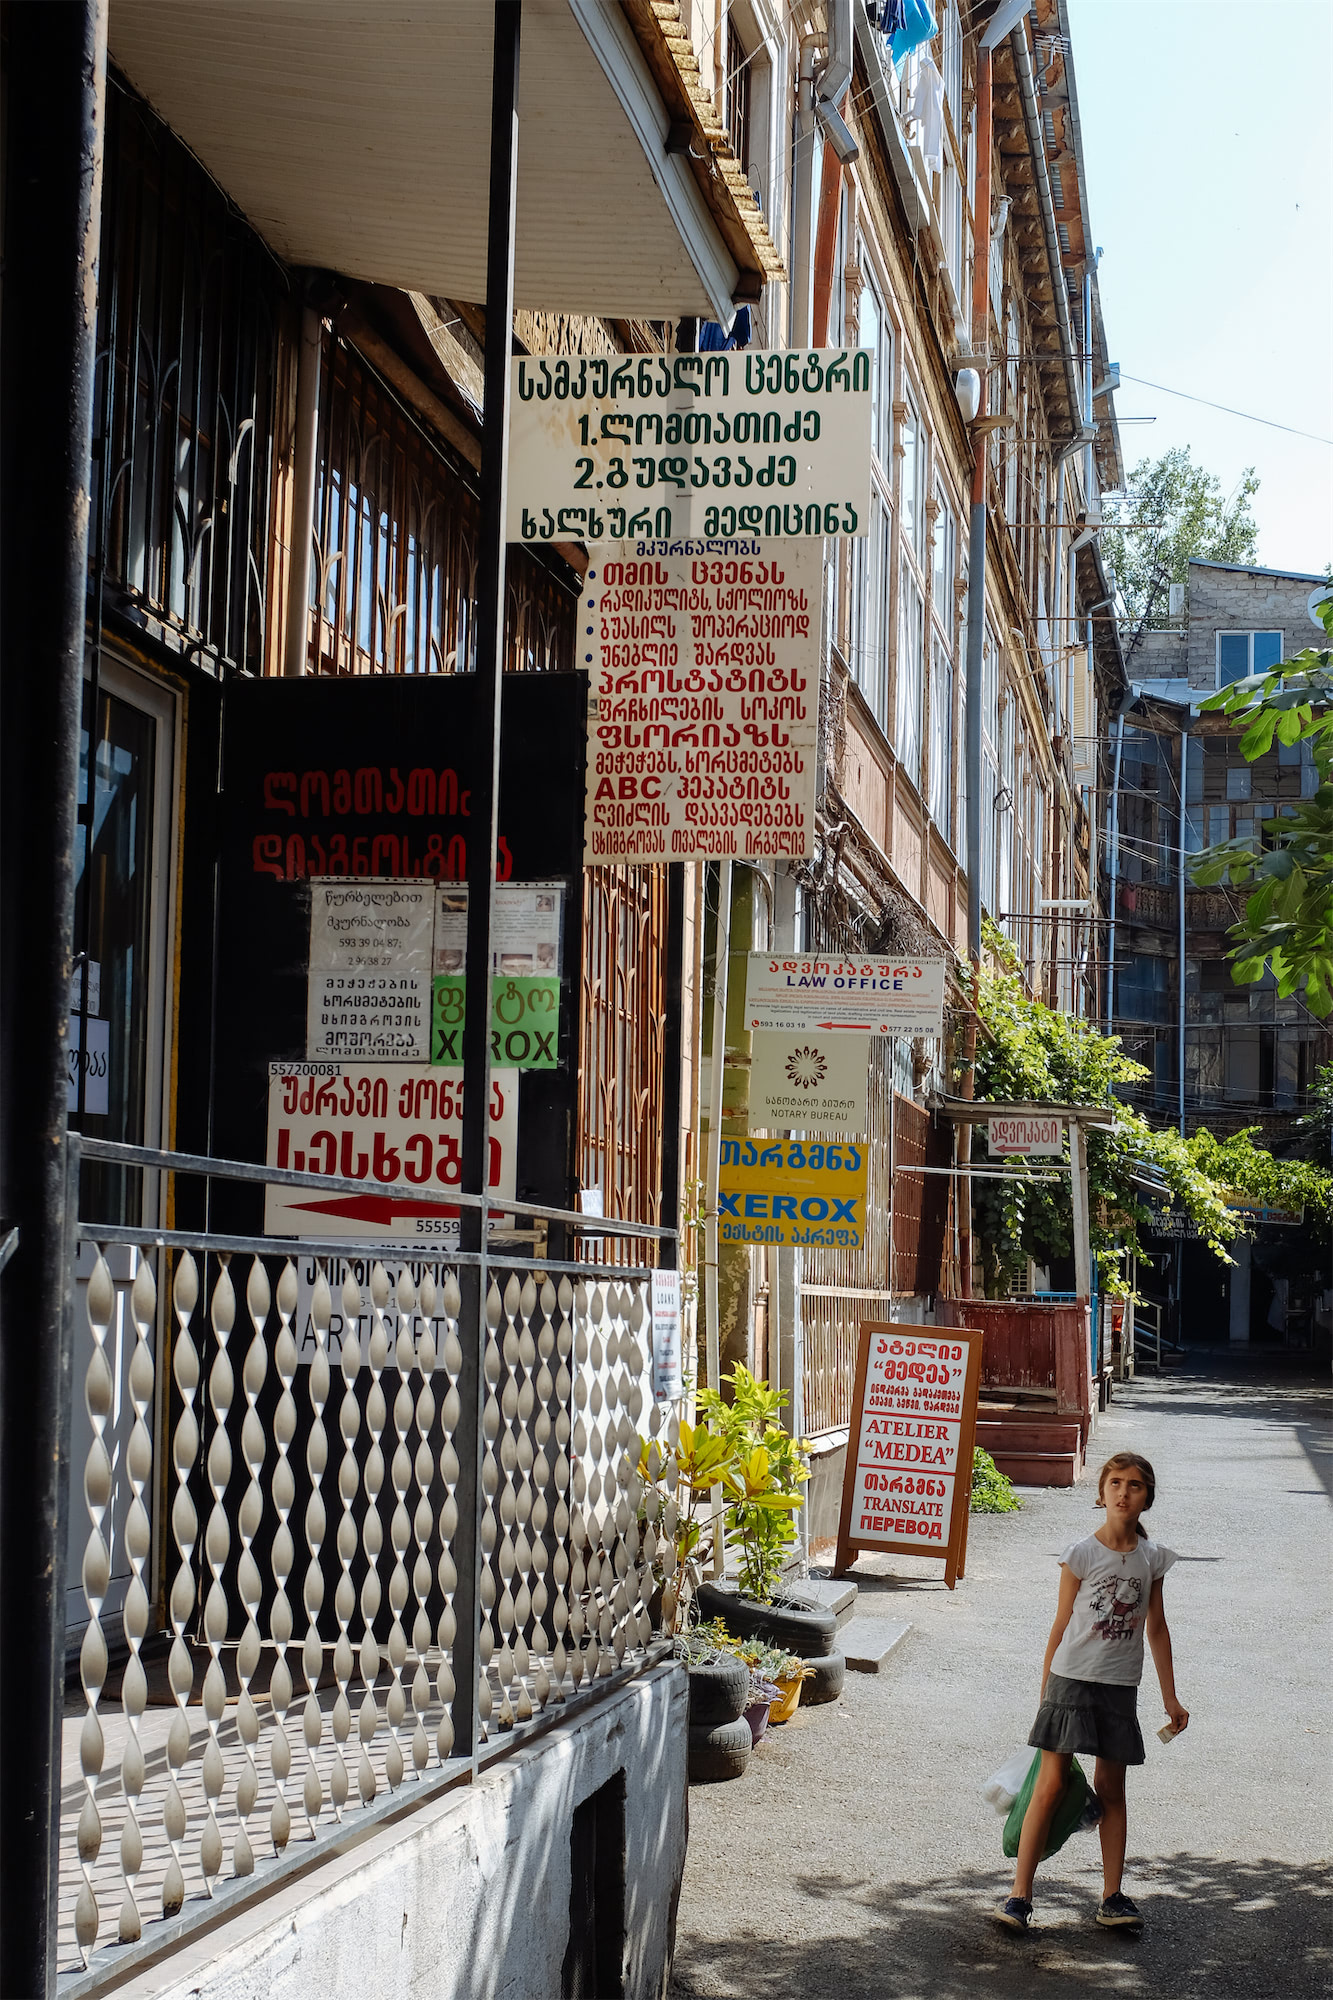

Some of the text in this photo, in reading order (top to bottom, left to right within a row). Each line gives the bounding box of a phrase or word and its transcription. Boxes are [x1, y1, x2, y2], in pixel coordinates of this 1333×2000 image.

[519, 351, 870, 400] სამკურნალო ცენტრი
[577, 410, 821, 446] 1.ლომთათიძე
[573, 455, 797, 490] 2.გუდავაძე
[522, 502, 858, 539] ხალხური მედიცინა
[636, 540, 761, 557] მკურნალობს
[603, 561, 785, 586] თმის ცვენას
[600, 588, 808, 613] რადიკულიტს, სქოლიოზს
[600, 614, 810, 640] ბუასილს უოპერაციოდ
[600, 642, 775, 668] უნებლიე შარდვას
[599, 669, 807, 695] პროსტატიტს
[600, 696, 807, 722] ფრჩხილების სოკოს
[596, 724, 790, 749] ფსორიაზს
[596, 750, 804, 775] მეჭეჭებს, ხორცმეტებს
[594, 775, 790, 800] ABC ჰეპატიტს
[593, 802, 804, 827] ღვიძლის დაავადებებს
[592, 829, 805, 855] ცხიმგროვას თვალების ირგვლივ
[327, 915, 411, 931] მკურნალობა
[339, 938, 356, 948] 593
[358, 938, 371, 948] 39
[768, 960, 923, 979] ადვოკატურა
[786, 975, 903, 991] LAW OFFICE
[323, 995, 421, 1009] ხორცმეტების
[437, 981, 556, 1025] ფტო
[760, 1020, 774, 1028] 593
[436, 1029, 555, 1062] XROX
[270, 1063, 342, 1076] 557200081
[281, 1076, 504, 1122] უძრავი ქონეა
[765, 1096, 855, 1109] სანოტარო ბიურო
[771, 1109, 848, 1121] NOTARY BUREAU
[991, 1121, 1058, 1144] ადვოკატი
[720, 1140, 861, 1172] თარგმნა
[718, 1192, 857, 1223] XEROX
[722, 1223, 860, 1247] ექსტის აკრეფა
[877, 1339, 962, 1361] ატელიე
[865, 1419, 950, 1441] ATELIER
[864, 1473, 945, 1497] თარგმნა
[863, 1496, 943, 1517] TRANSLATE
[860, 1515, 942, 1540] ПЕРЕВОД
